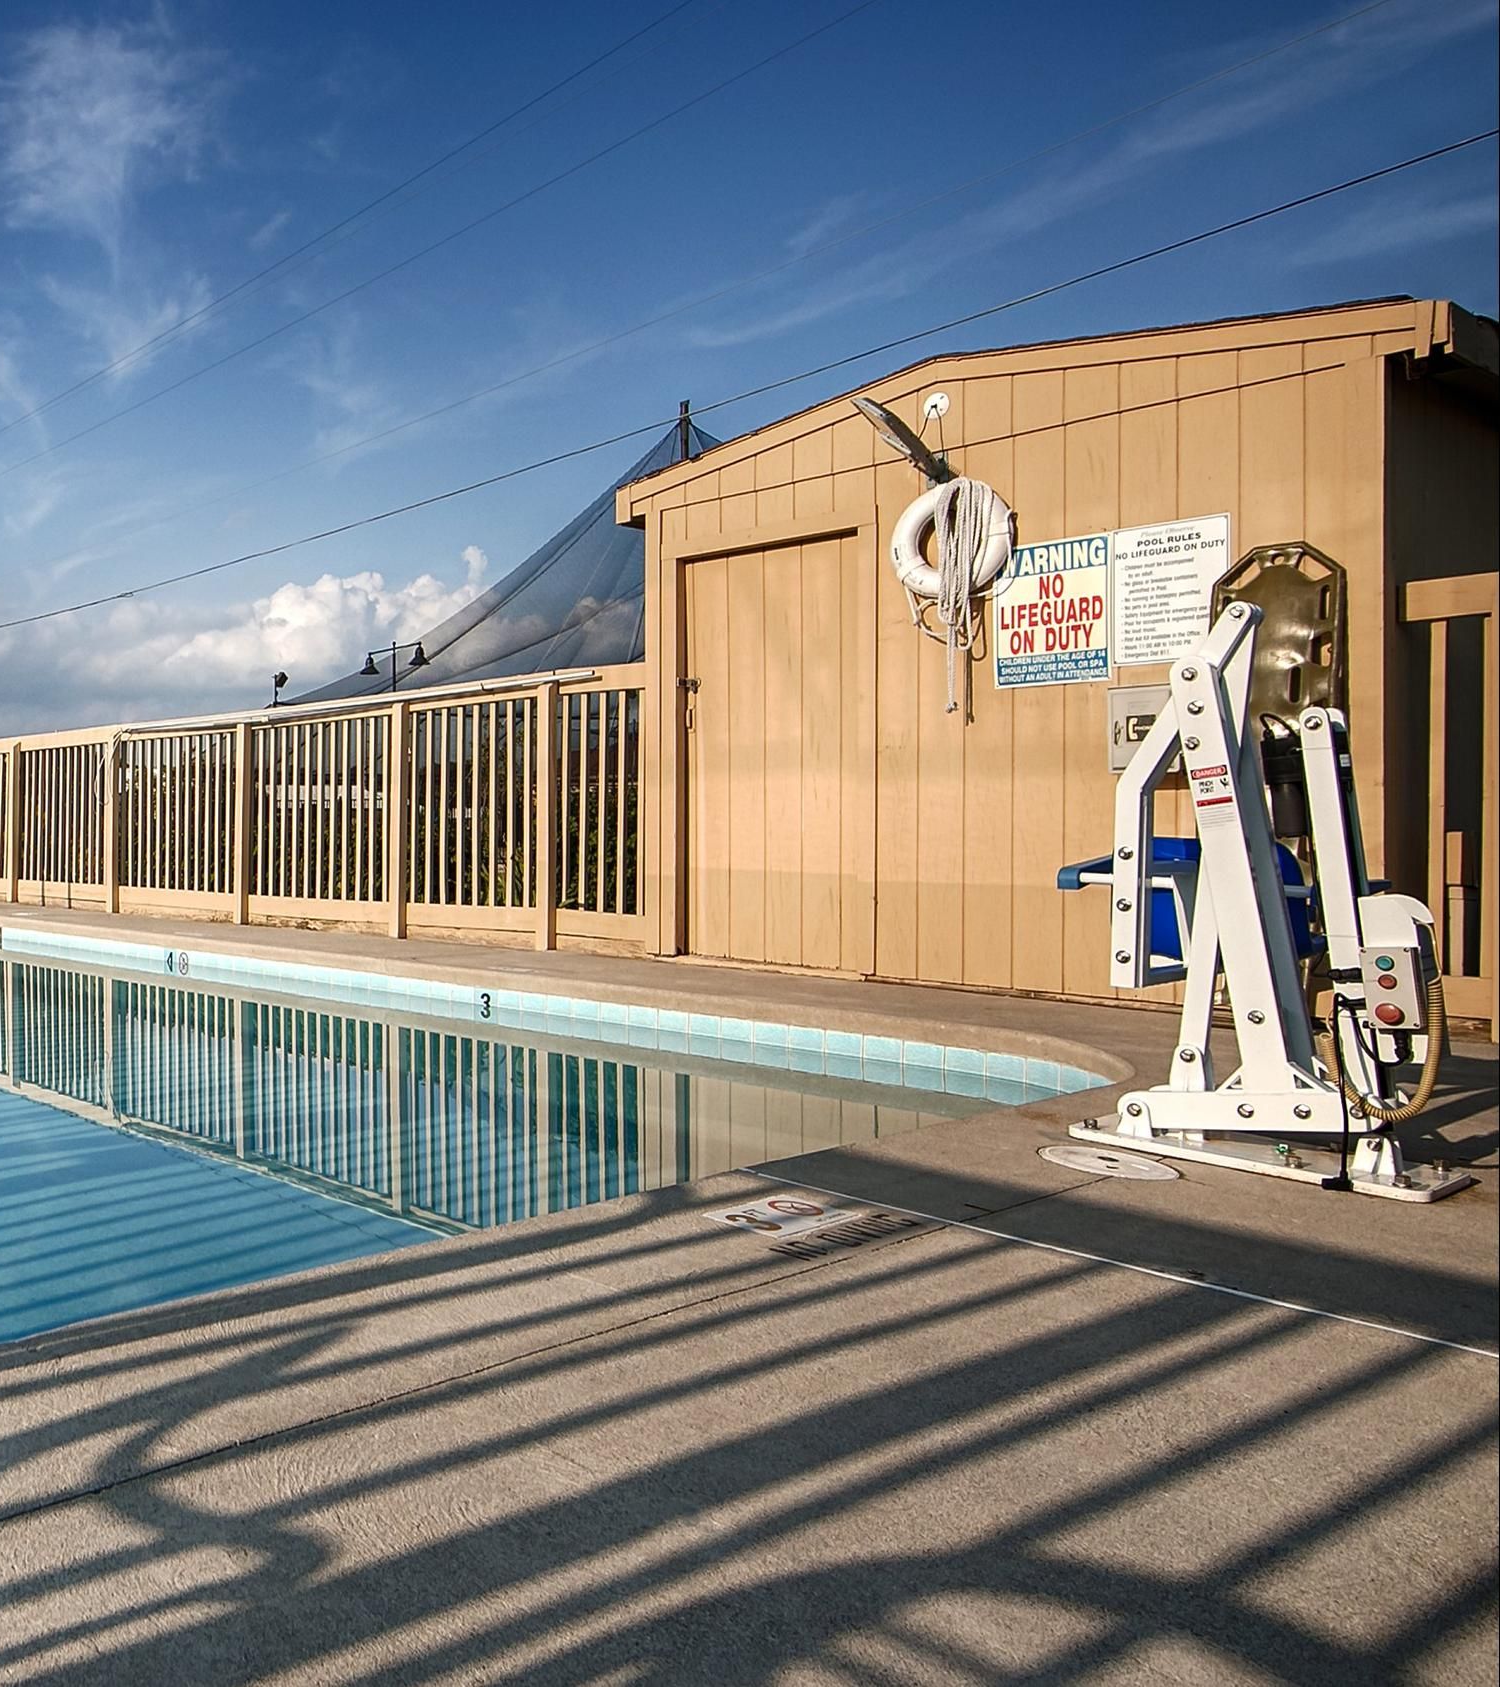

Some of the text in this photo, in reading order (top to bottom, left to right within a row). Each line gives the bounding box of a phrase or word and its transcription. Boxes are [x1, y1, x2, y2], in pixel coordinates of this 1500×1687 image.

[1115, 538, 1226, 560] NO LIFEGUARD ON DUTY
[1137, 532, 1202, 548] POOL RULES
[1039, 573, 1064, 600] NO
[1001, 595, 1104, 630] LIFEGUARD
[1010, 623, 1094, 655] ON DUTY
[999, 656, 1032, 666] CHILDREN
[1032, 654, 1056, 663] UNDER
[1056, 652, 1070, 661] THE
[1071, 651, 1085, 660] AGE
[1086, 650, 1096, 659] OF
[1001, 659, 1104, 675] SHOULD NOT USE POOL OR SPA
[999, 674, 1025, 683] WITHOUT
[1025, 673, 1035, 681] AN
[1035, 672, 1057, 681] ADULT
[1057, 671, 1065, 679] IN
[1065, 667, 1108, 679] ATTENDANCE
[1195, 767, 1222, 778] DANGER
[480, 993, 491, 1018] 3
[725, 1214, 782, 1231] 3
[768, 1213, 921, 1262] NO DIVING
